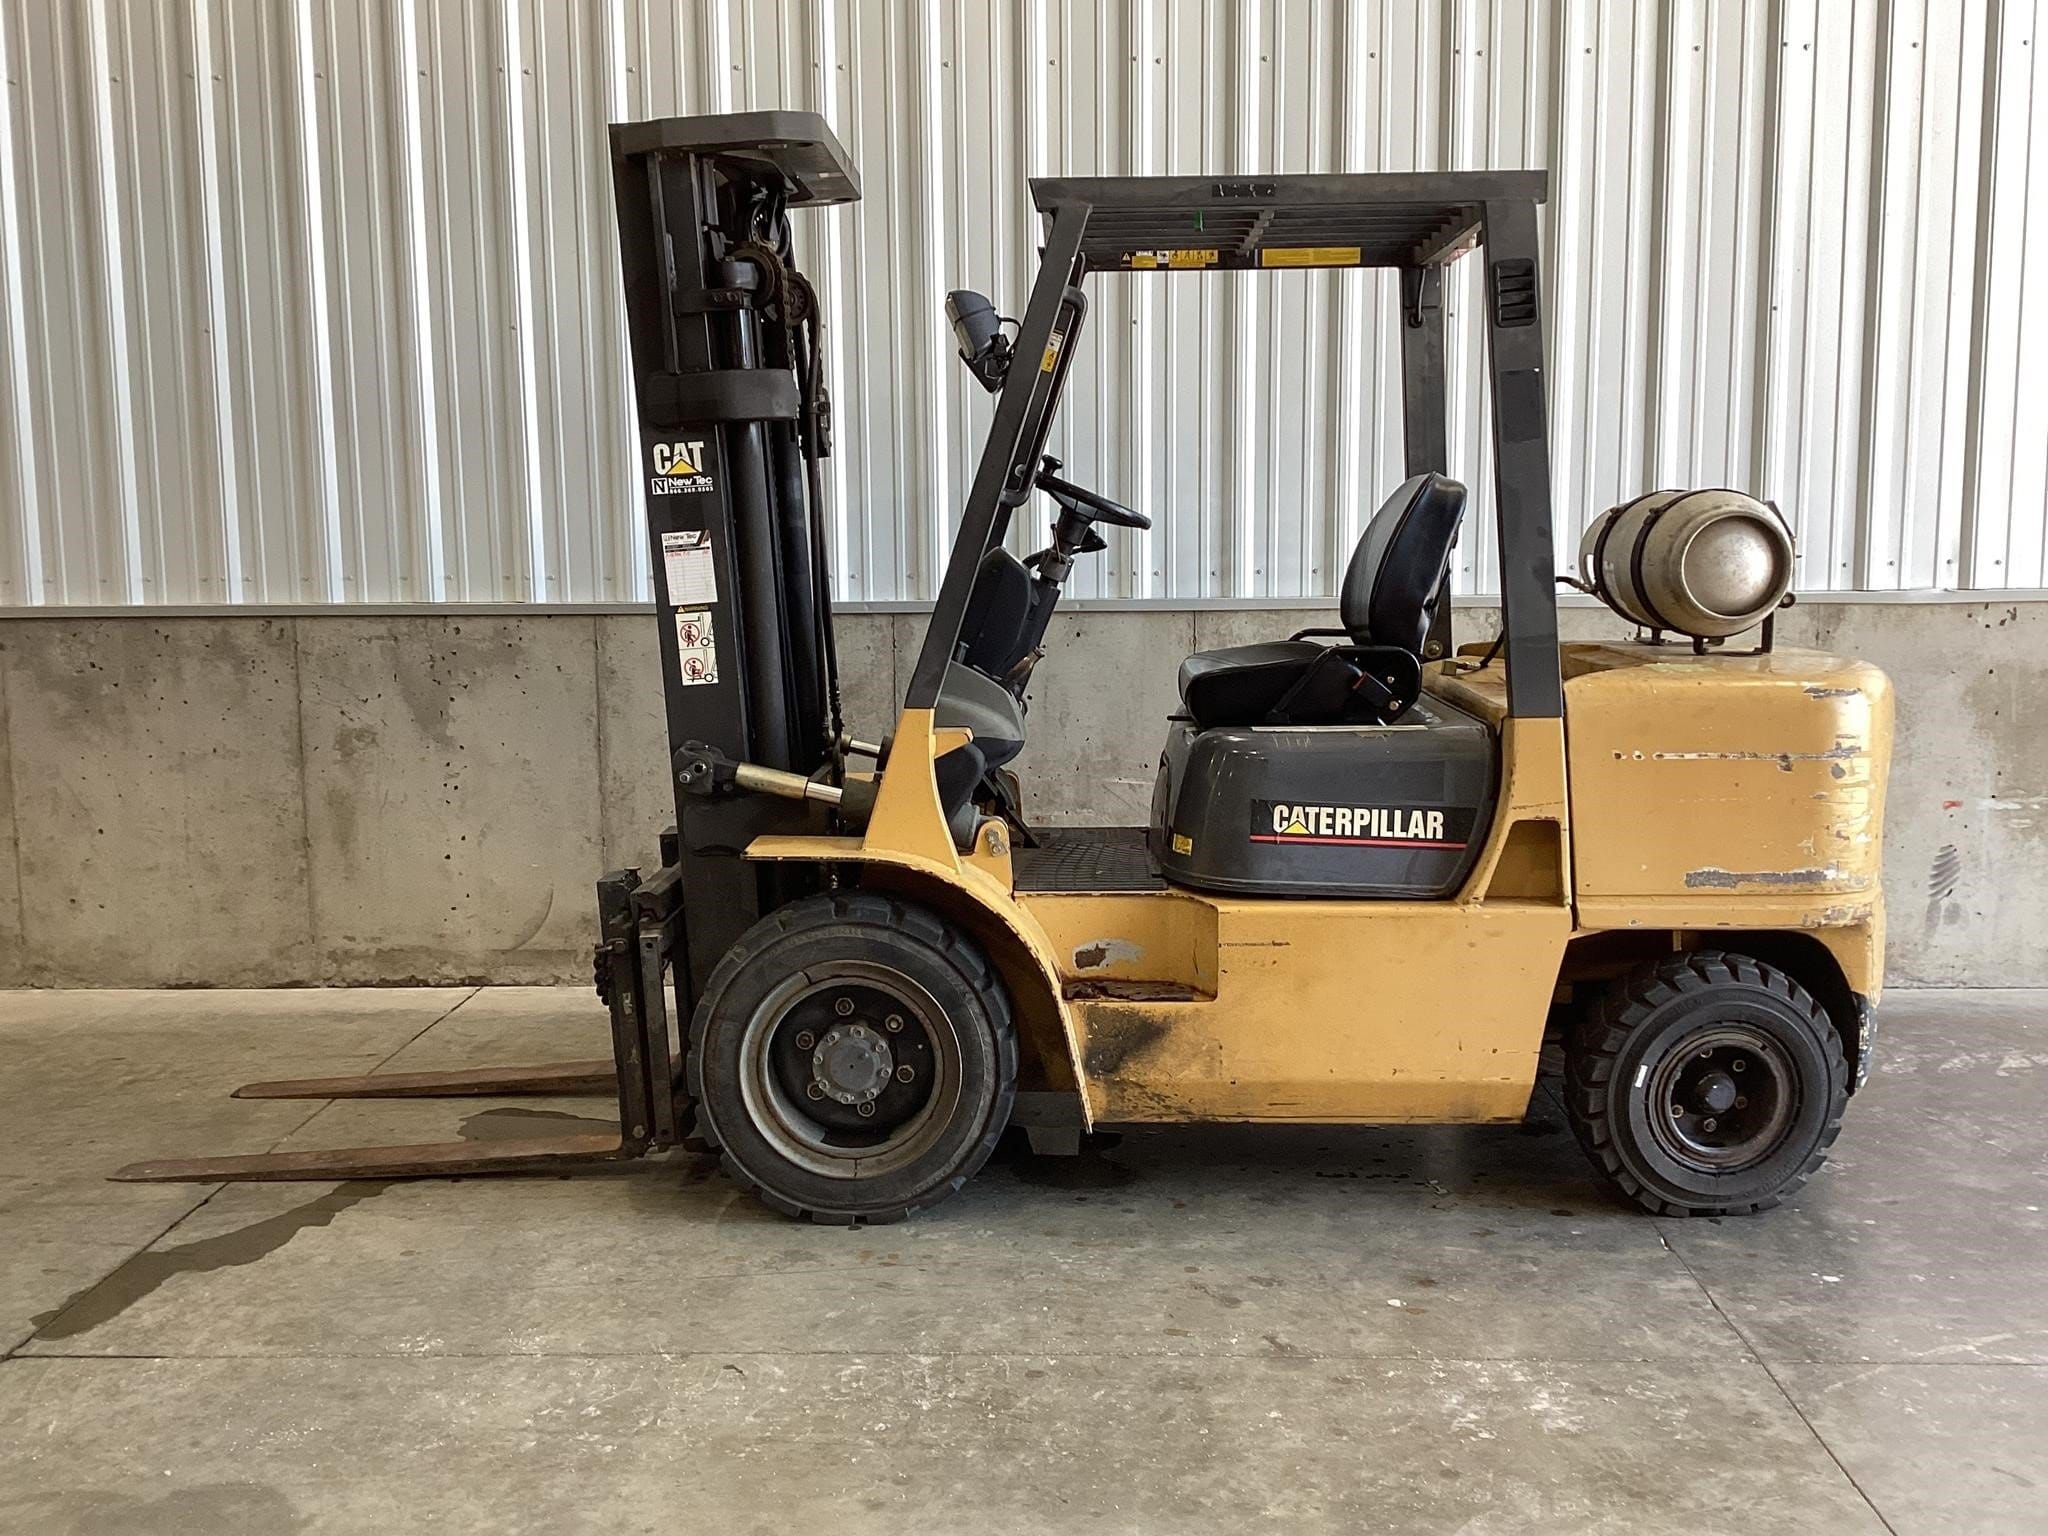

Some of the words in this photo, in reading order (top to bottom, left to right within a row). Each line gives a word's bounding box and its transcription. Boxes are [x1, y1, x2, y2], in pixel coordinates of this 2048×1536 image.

[653, 441, 704, 475] CAT
[668, 477, 693, 487] New
[693, 475, 713, 485] Tec
[1273, 804, 1444, 839] CATERPILLAR
